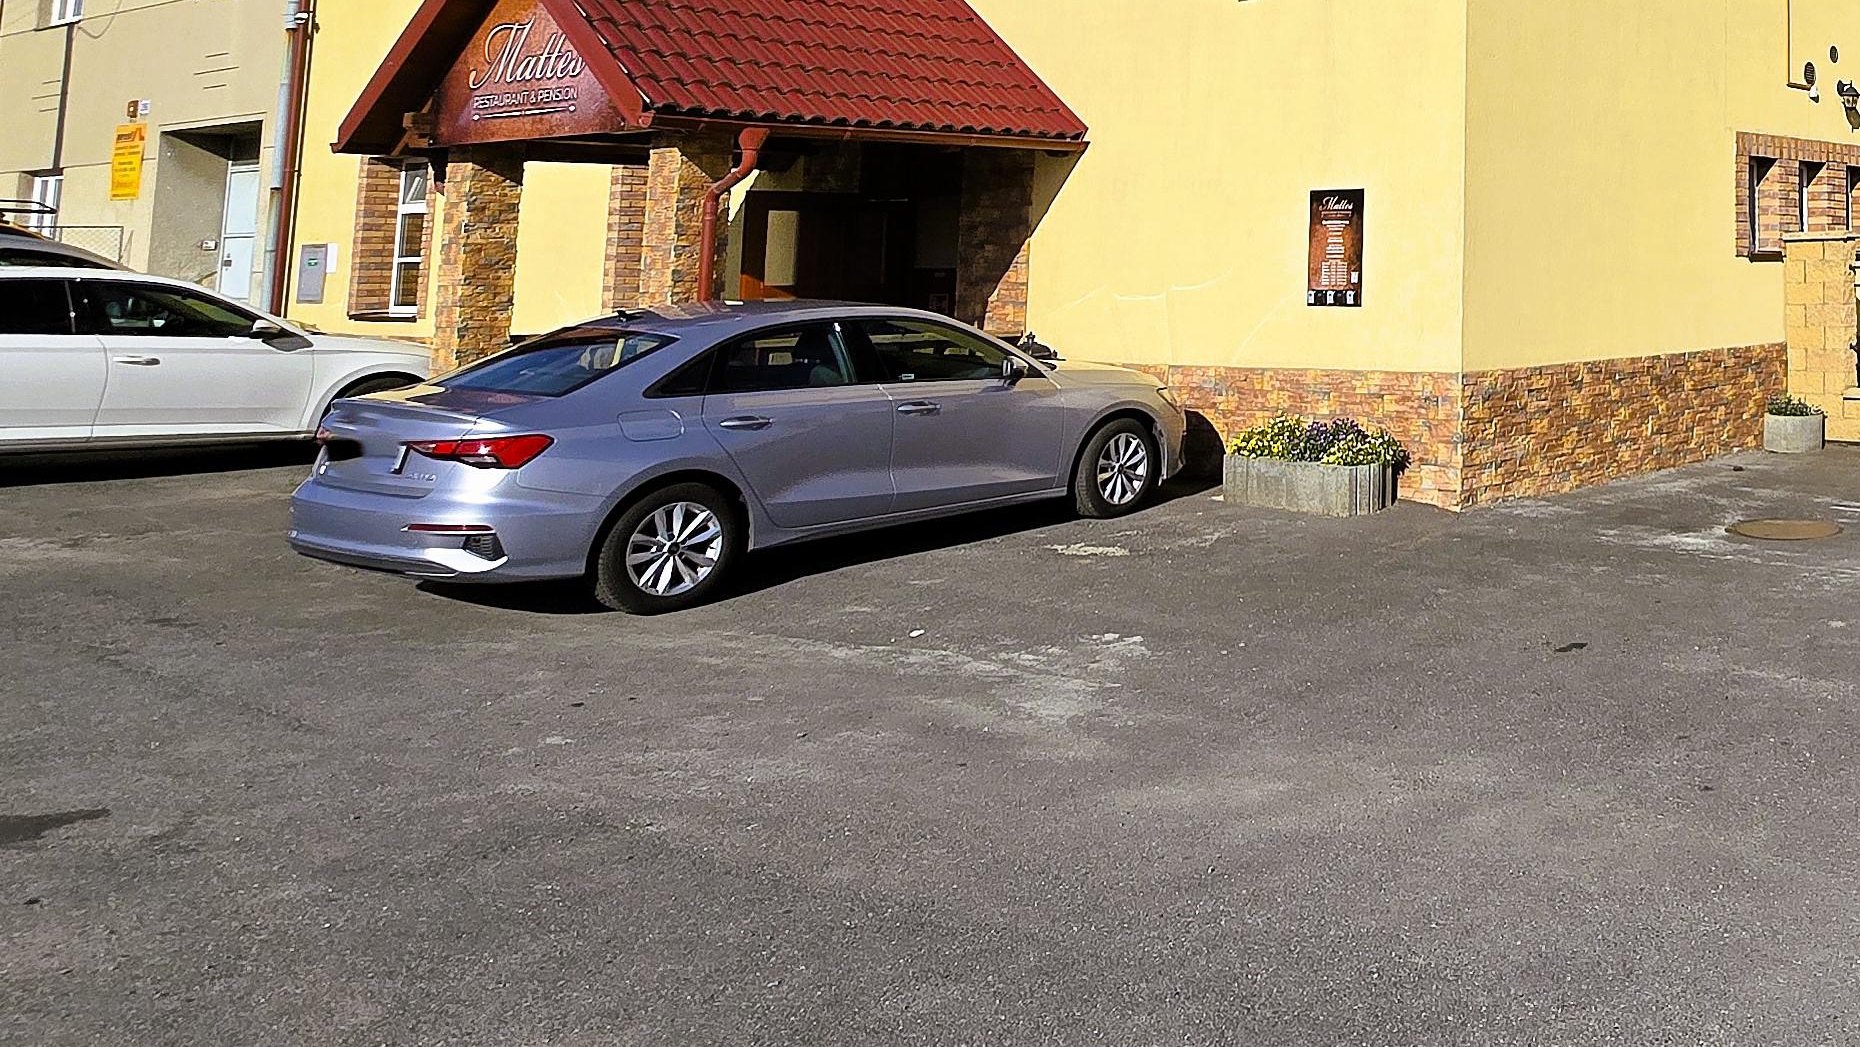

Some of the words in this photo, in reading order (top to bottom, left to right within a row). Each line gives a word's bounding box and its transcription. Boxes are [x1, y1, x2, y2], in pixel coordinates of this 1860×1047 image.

[468, 14, 586, 89] Mattes
[473, 91, 529, 109] RESTAURANT
[530, 89, 536, 104] &
[537, 87, 578, 103] PENSION
